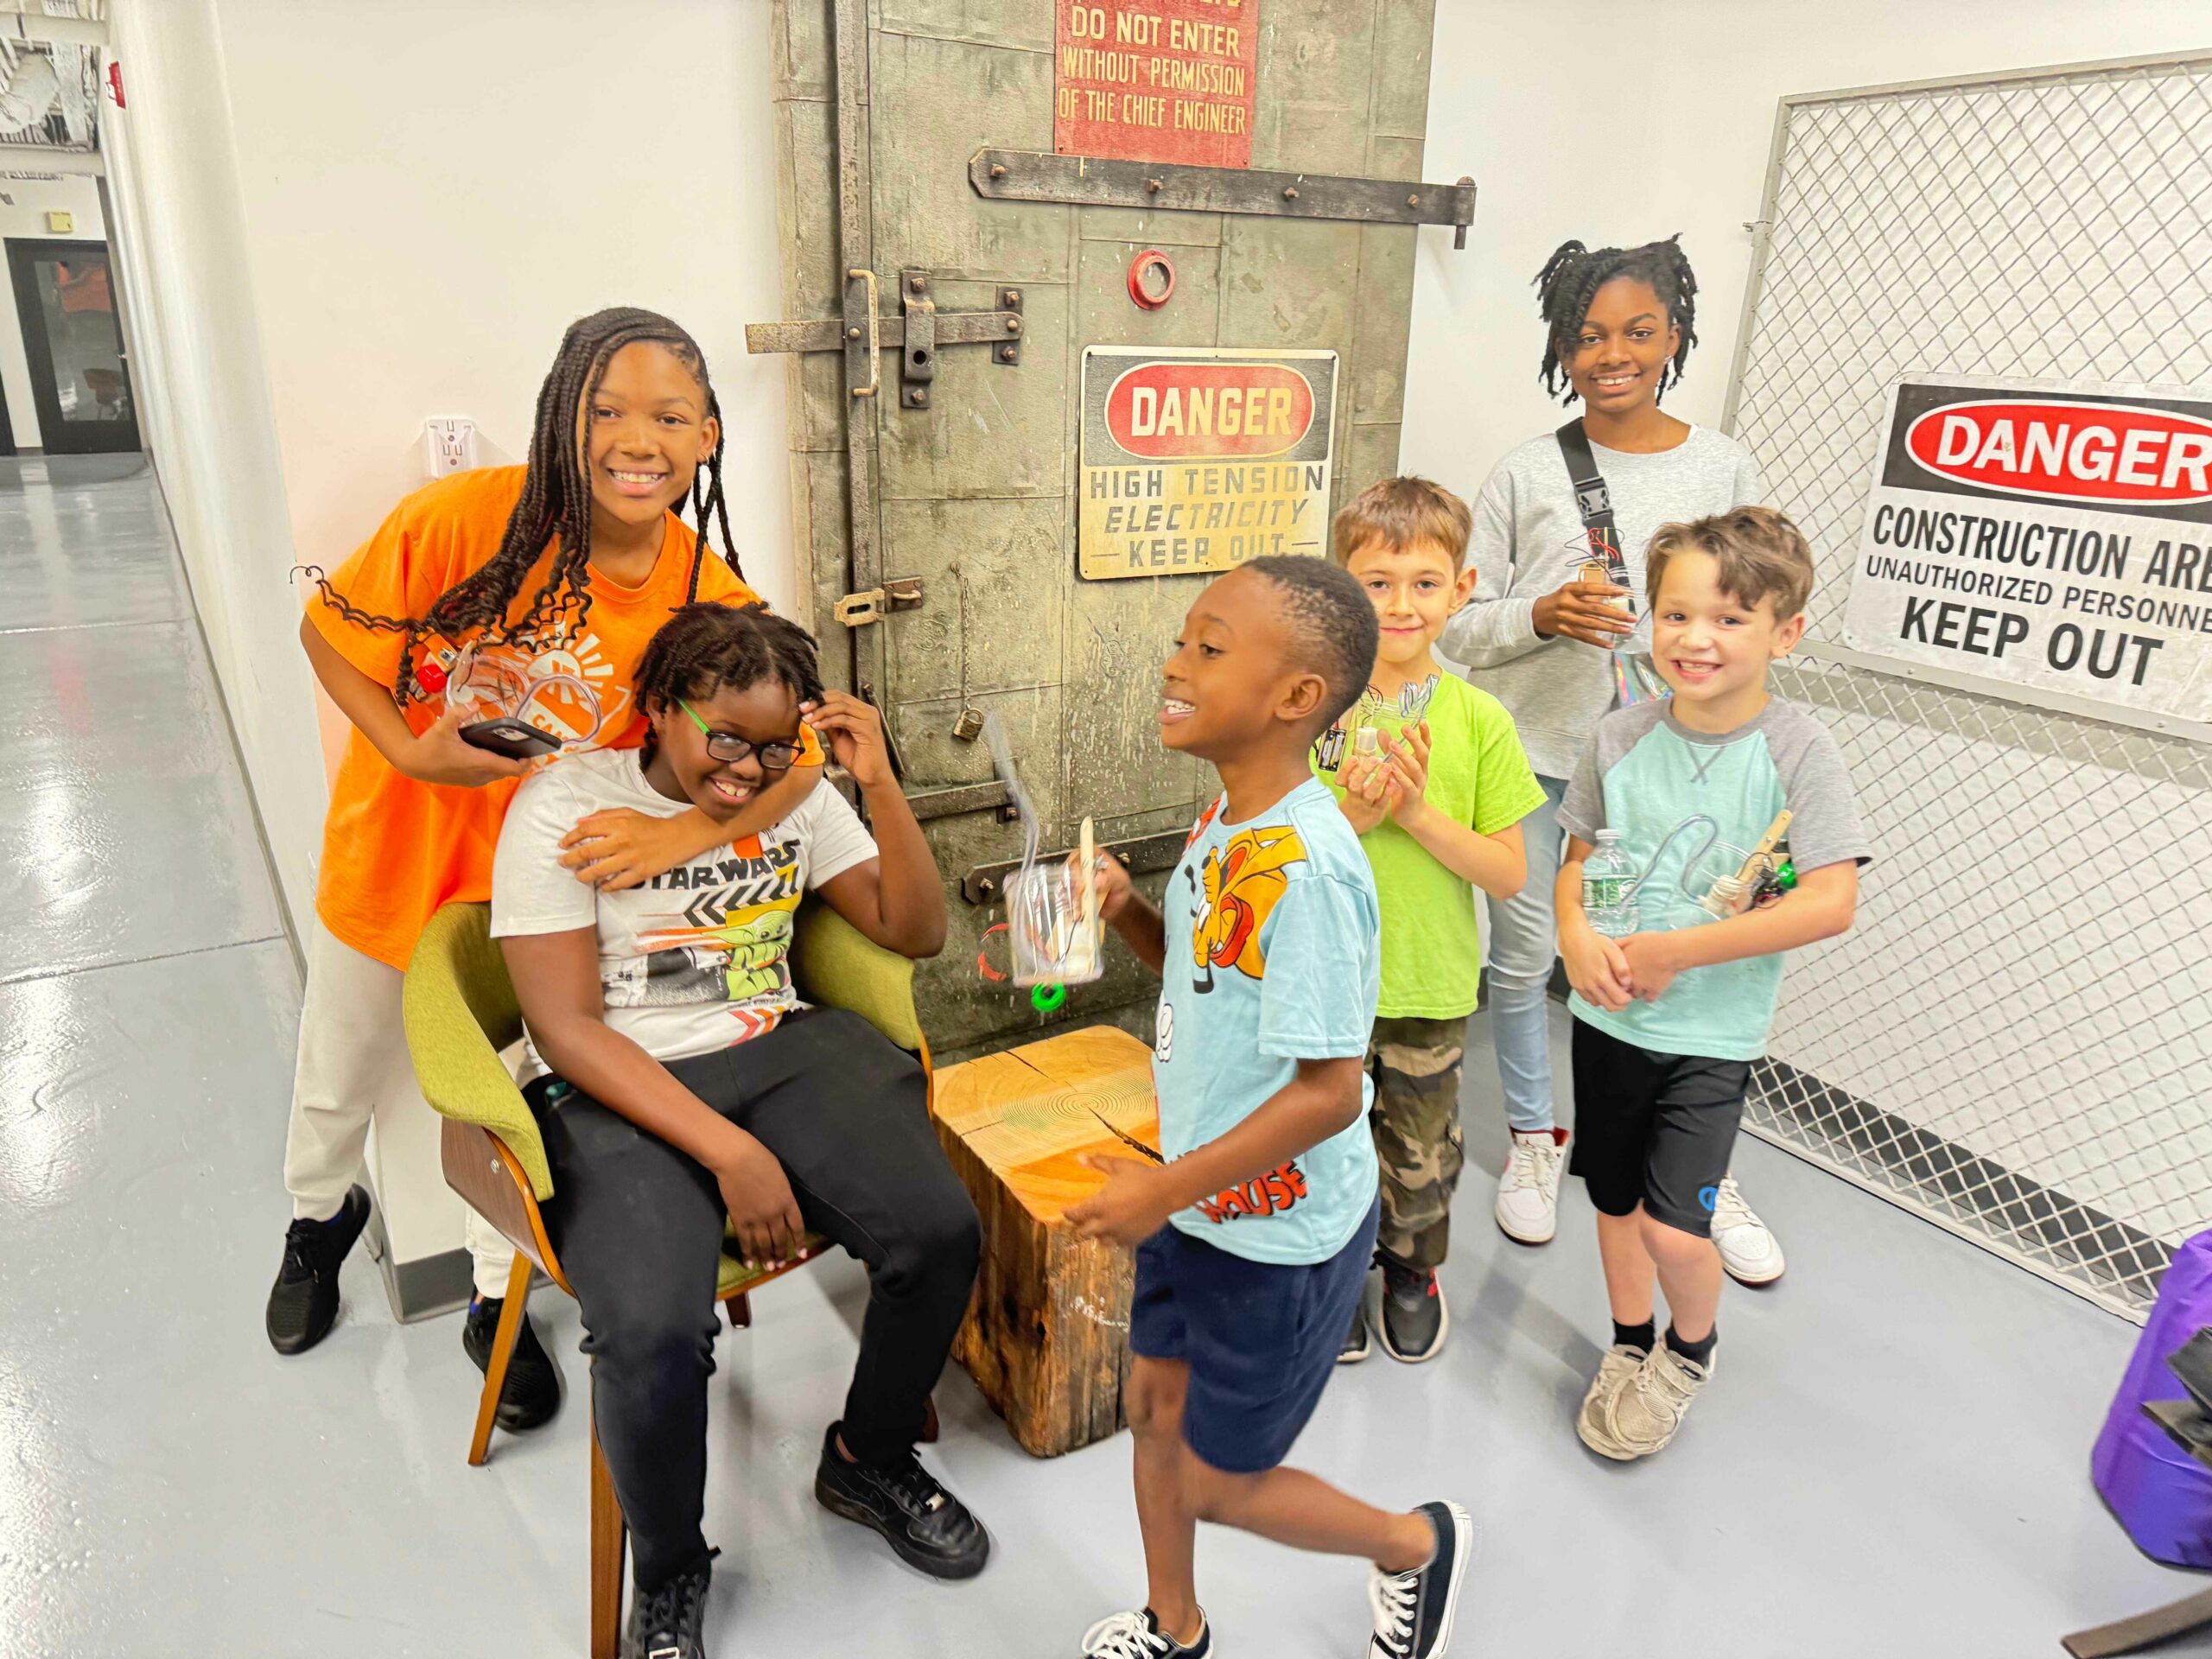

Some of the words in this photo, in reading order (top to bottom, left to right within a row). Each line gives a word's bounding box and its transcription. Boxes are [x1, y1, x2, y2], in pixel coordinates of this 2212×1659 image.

[1071, 6, 1106, 40] DO
[1116, 12, 1161, 47] NOT
[1170, 20, 1240, 58] ENTER
[1063, 46, 1141, 85] WITHOUT
[1150, 58, 1245, 97] PERMISSION
[1058, 87, 1081, 119] OF
[1085, 90, 1116, 123] THE
[1122, 94, 1166, 129] CHIEF
[1175, 100, 1246, 135] ENGINEER
[1131, 386, 1293, 436] DANGER
[1936, 415, 2212, 492] DANGER
[1090, 469, 1162, 499] HIGH
[1185, 465, 1324, 496] TENSION
[1104, 499, 1308, 534] ELECTRICITY
[1873, 504, 2132, 580] CONSTRUCTION
[1128, 537, 1210, 568] KEEP
[1230, 532, 1285, 562] OUT
[1866, 555, 2053, 606] UNAUTHORIZED
[1900, 596, 2030, 658] KEEP
[2047, 623, 2165, 686] OUT
[628, 867, 719, 890] TAR
[716, 838, 801, 883] WARS
